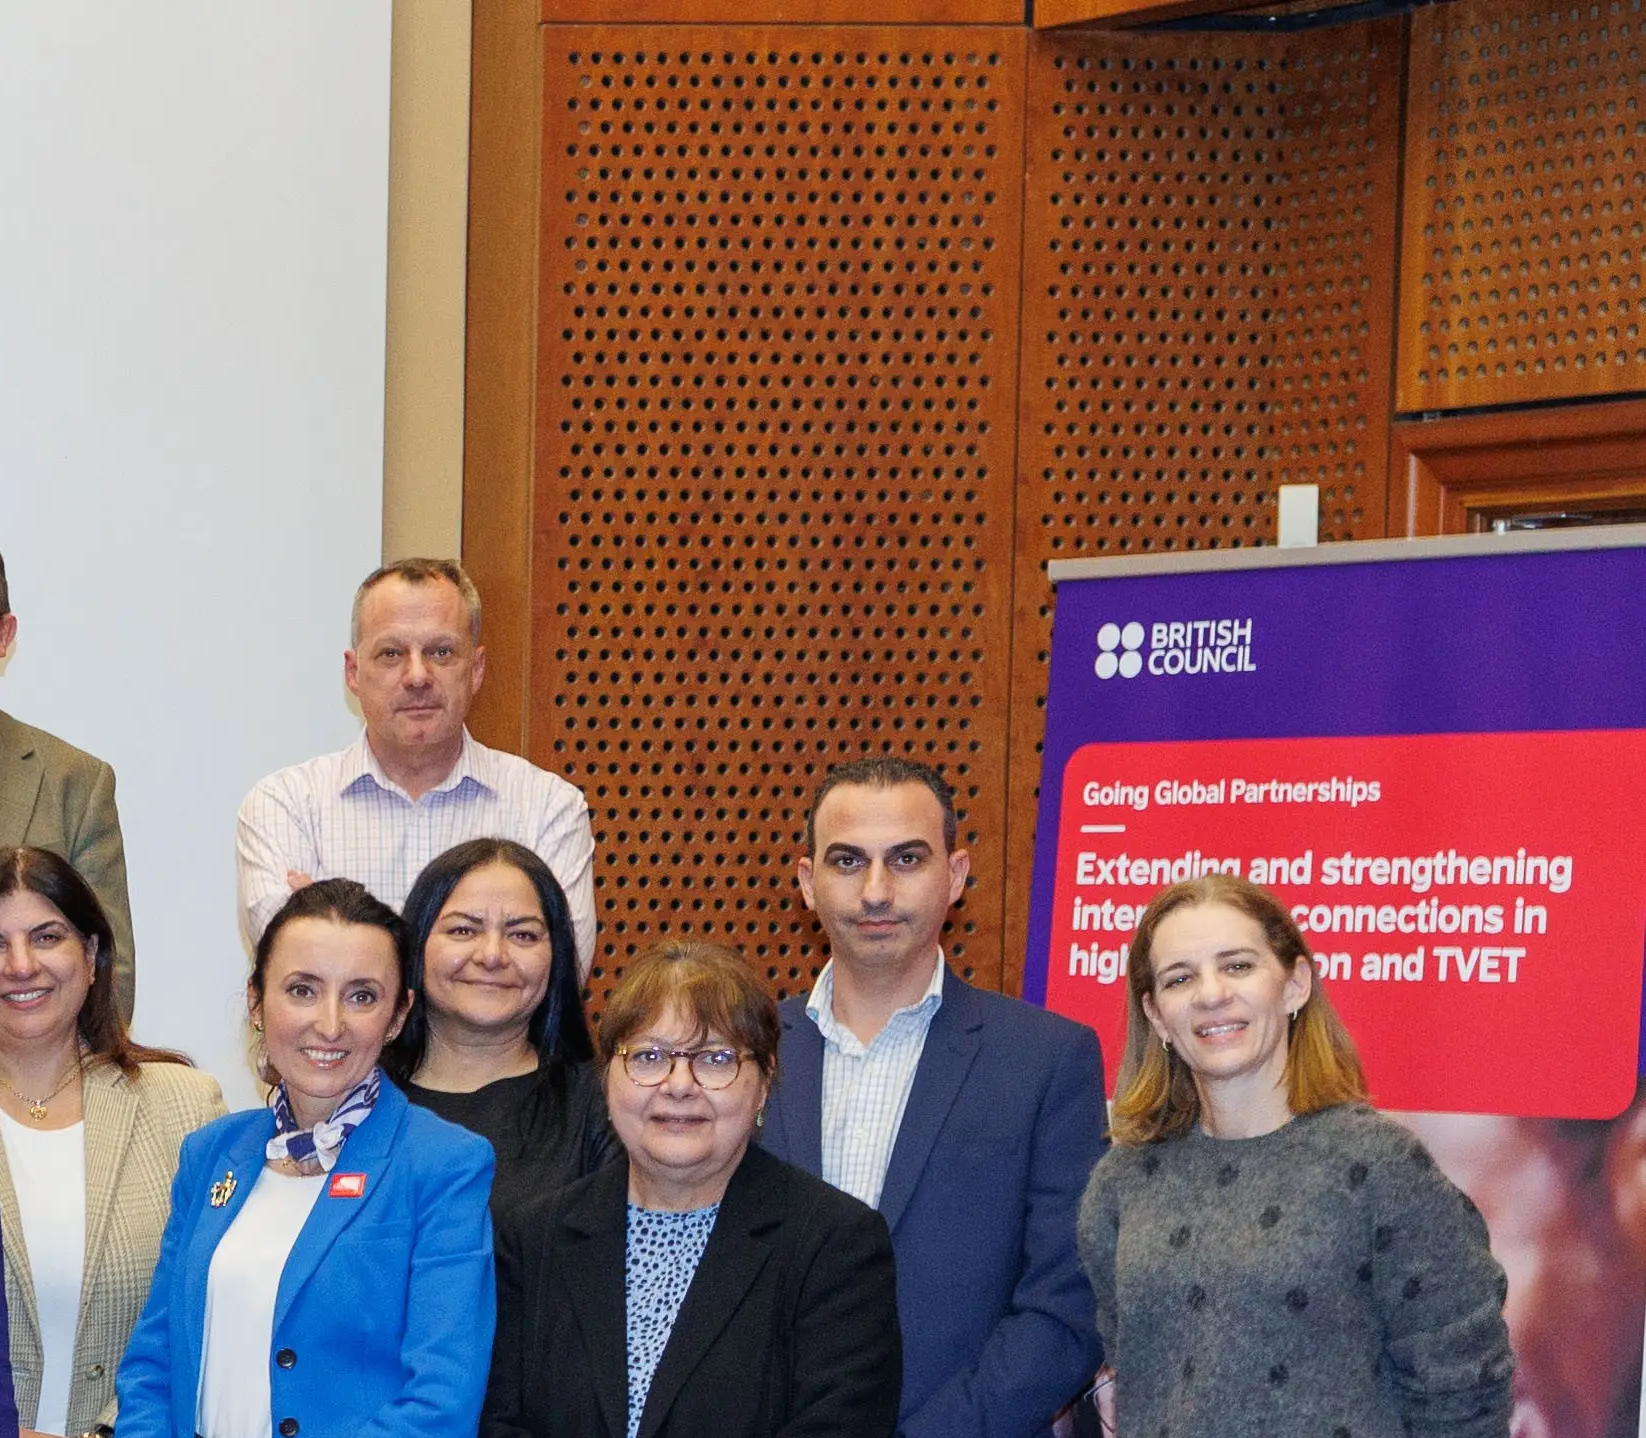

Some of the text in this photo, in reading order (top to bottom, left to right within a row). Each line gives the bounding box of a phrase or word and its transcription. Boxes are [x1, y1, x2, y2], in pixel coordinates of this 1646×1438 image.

[1150, 617, 1254, 649] BRITISH
[1147, 645, 1257, 676] COUNCIL
[1082, 776, 1382, 811] Going Global Partnerships
[1247, 849, 1314, 886] and
[1320, 847, 1573, 894] strengthening
[1291, 896, 1548, 935] connections in
[1360, 945, 1426, 983] and
[1431, 946, 1528, 984] TVET
